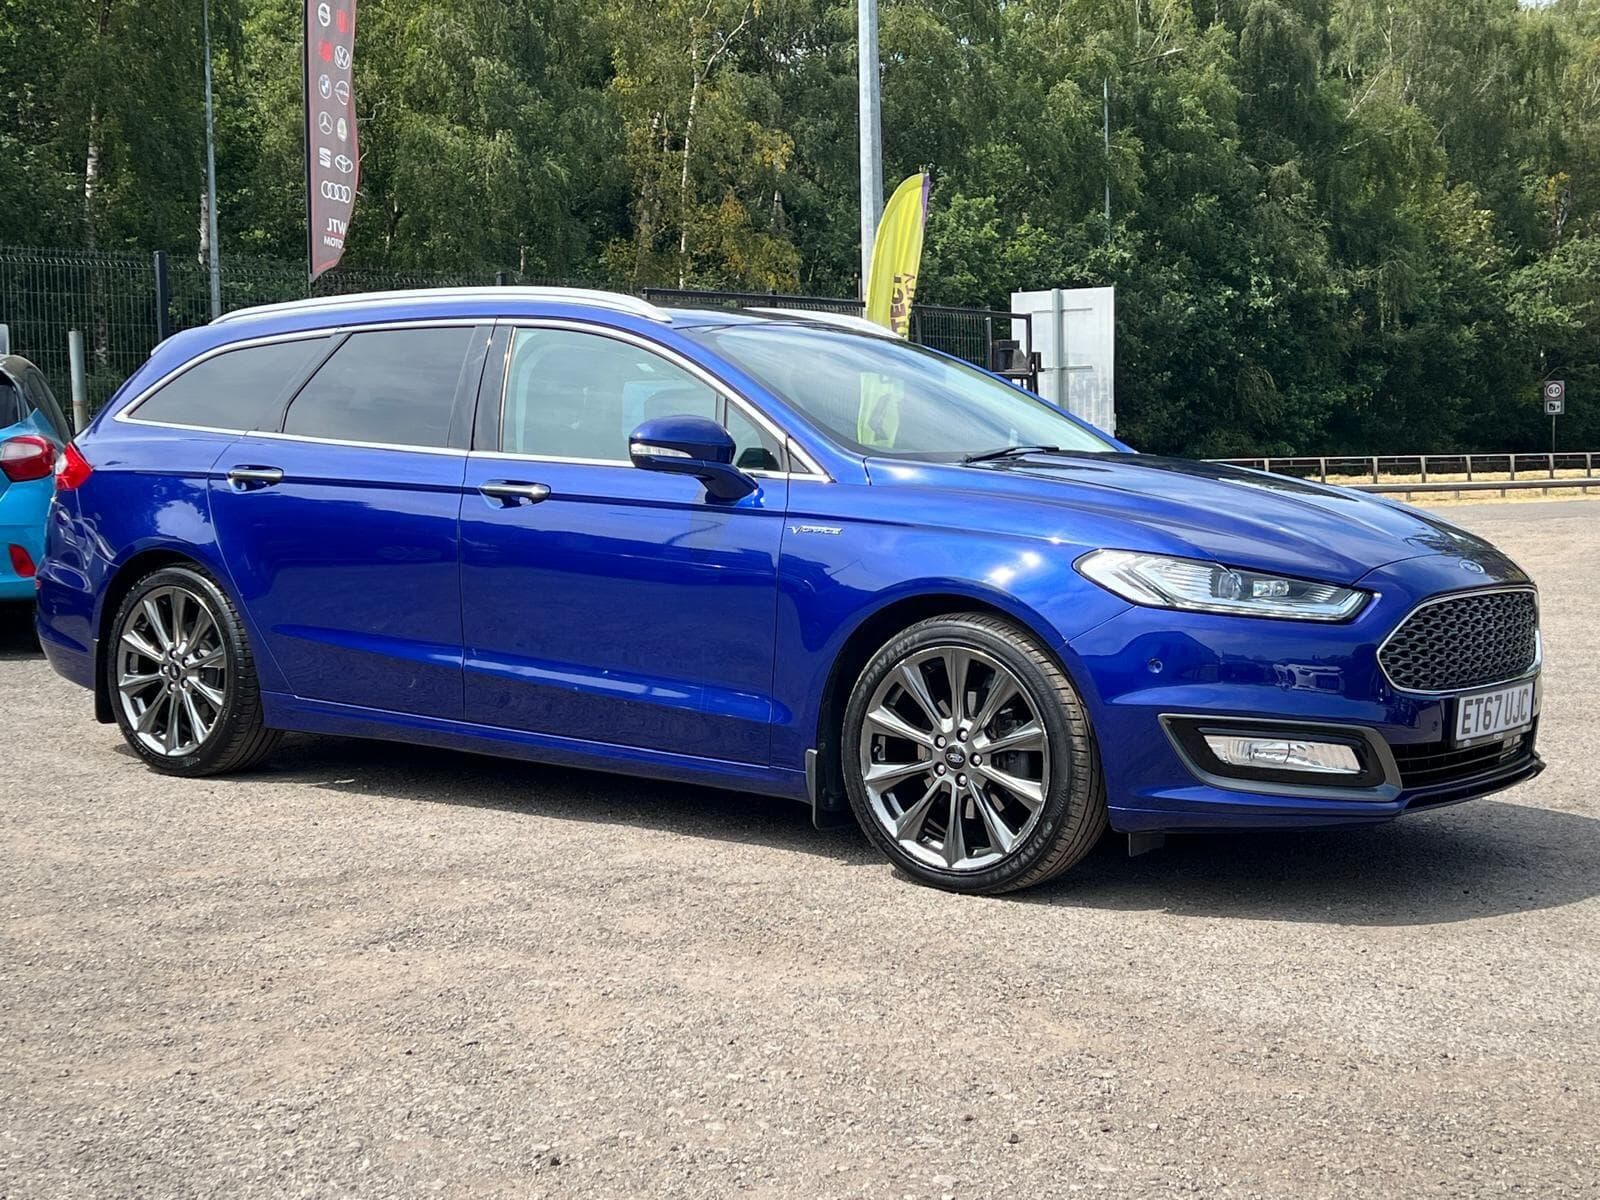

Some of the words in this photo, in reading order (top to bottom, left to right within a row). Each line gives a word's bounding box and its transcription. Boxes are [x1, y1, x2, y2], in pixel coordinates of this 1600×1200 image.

[326, 217, 347, 236] JTW
[1461, 694, 1503, 735] ET67
[1504, 688, 1529, 726] UJC
